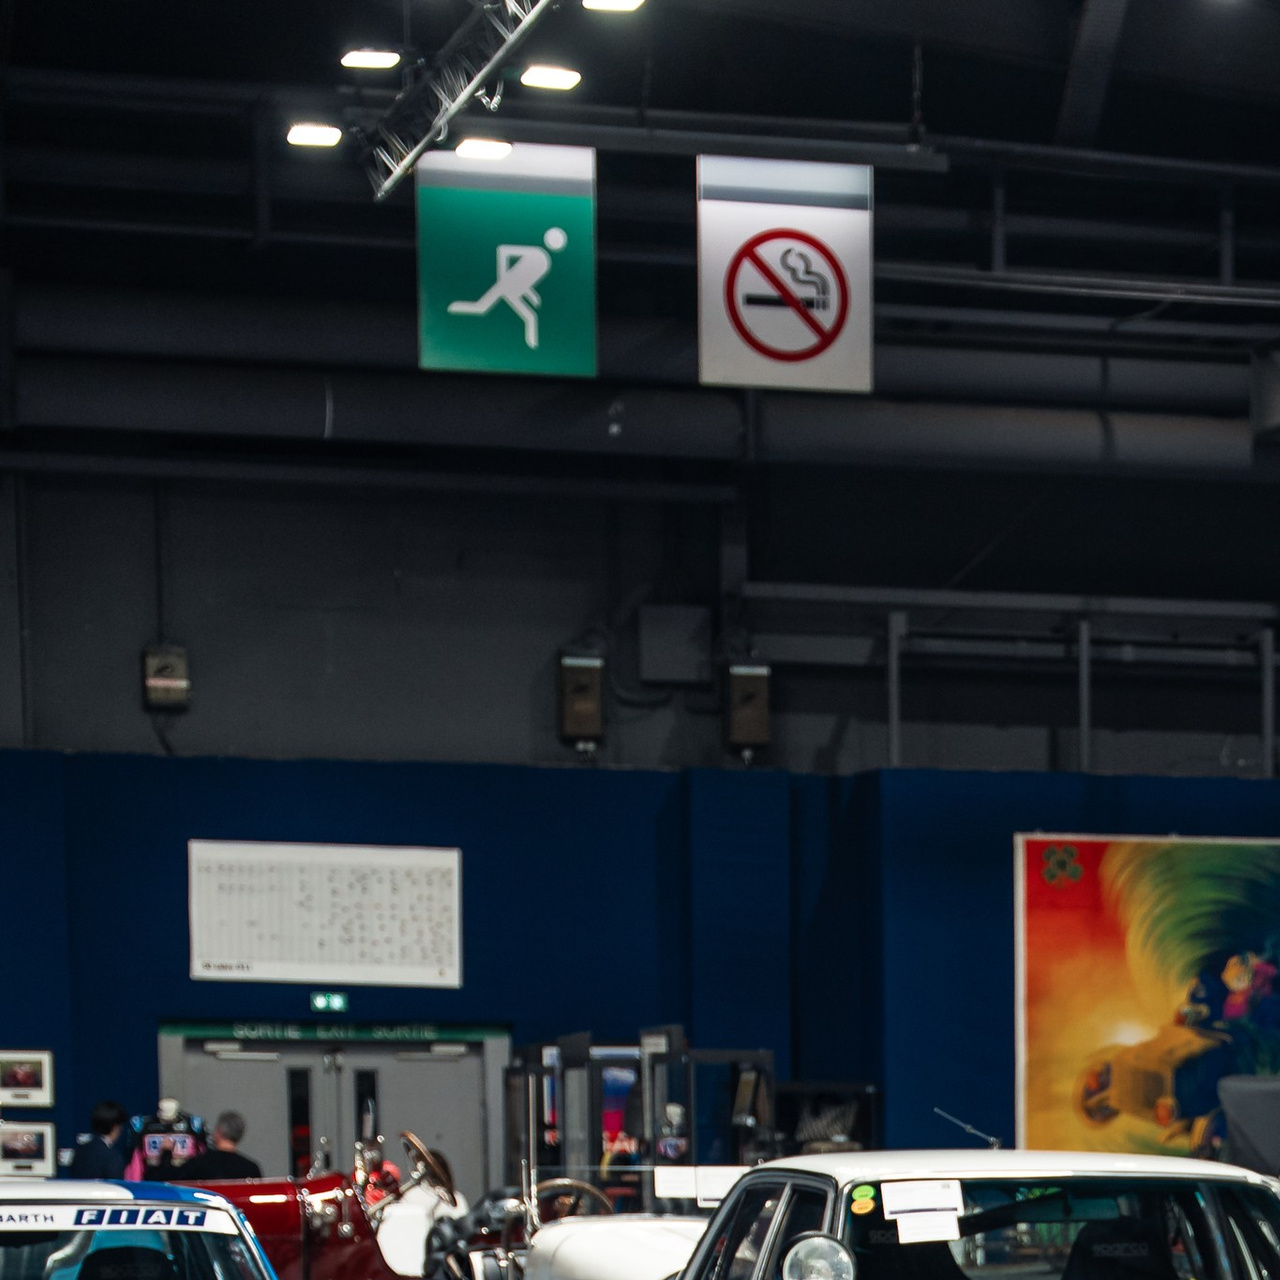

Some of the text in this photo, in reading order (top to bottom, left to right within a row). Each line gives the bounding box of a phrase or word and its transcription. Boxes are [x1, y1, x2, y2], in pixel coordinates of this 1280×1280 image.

[233, 1024, 438, 1040] SORTIE EXIT SORTIE
[77, 1208, 204, 1227] FIAT
